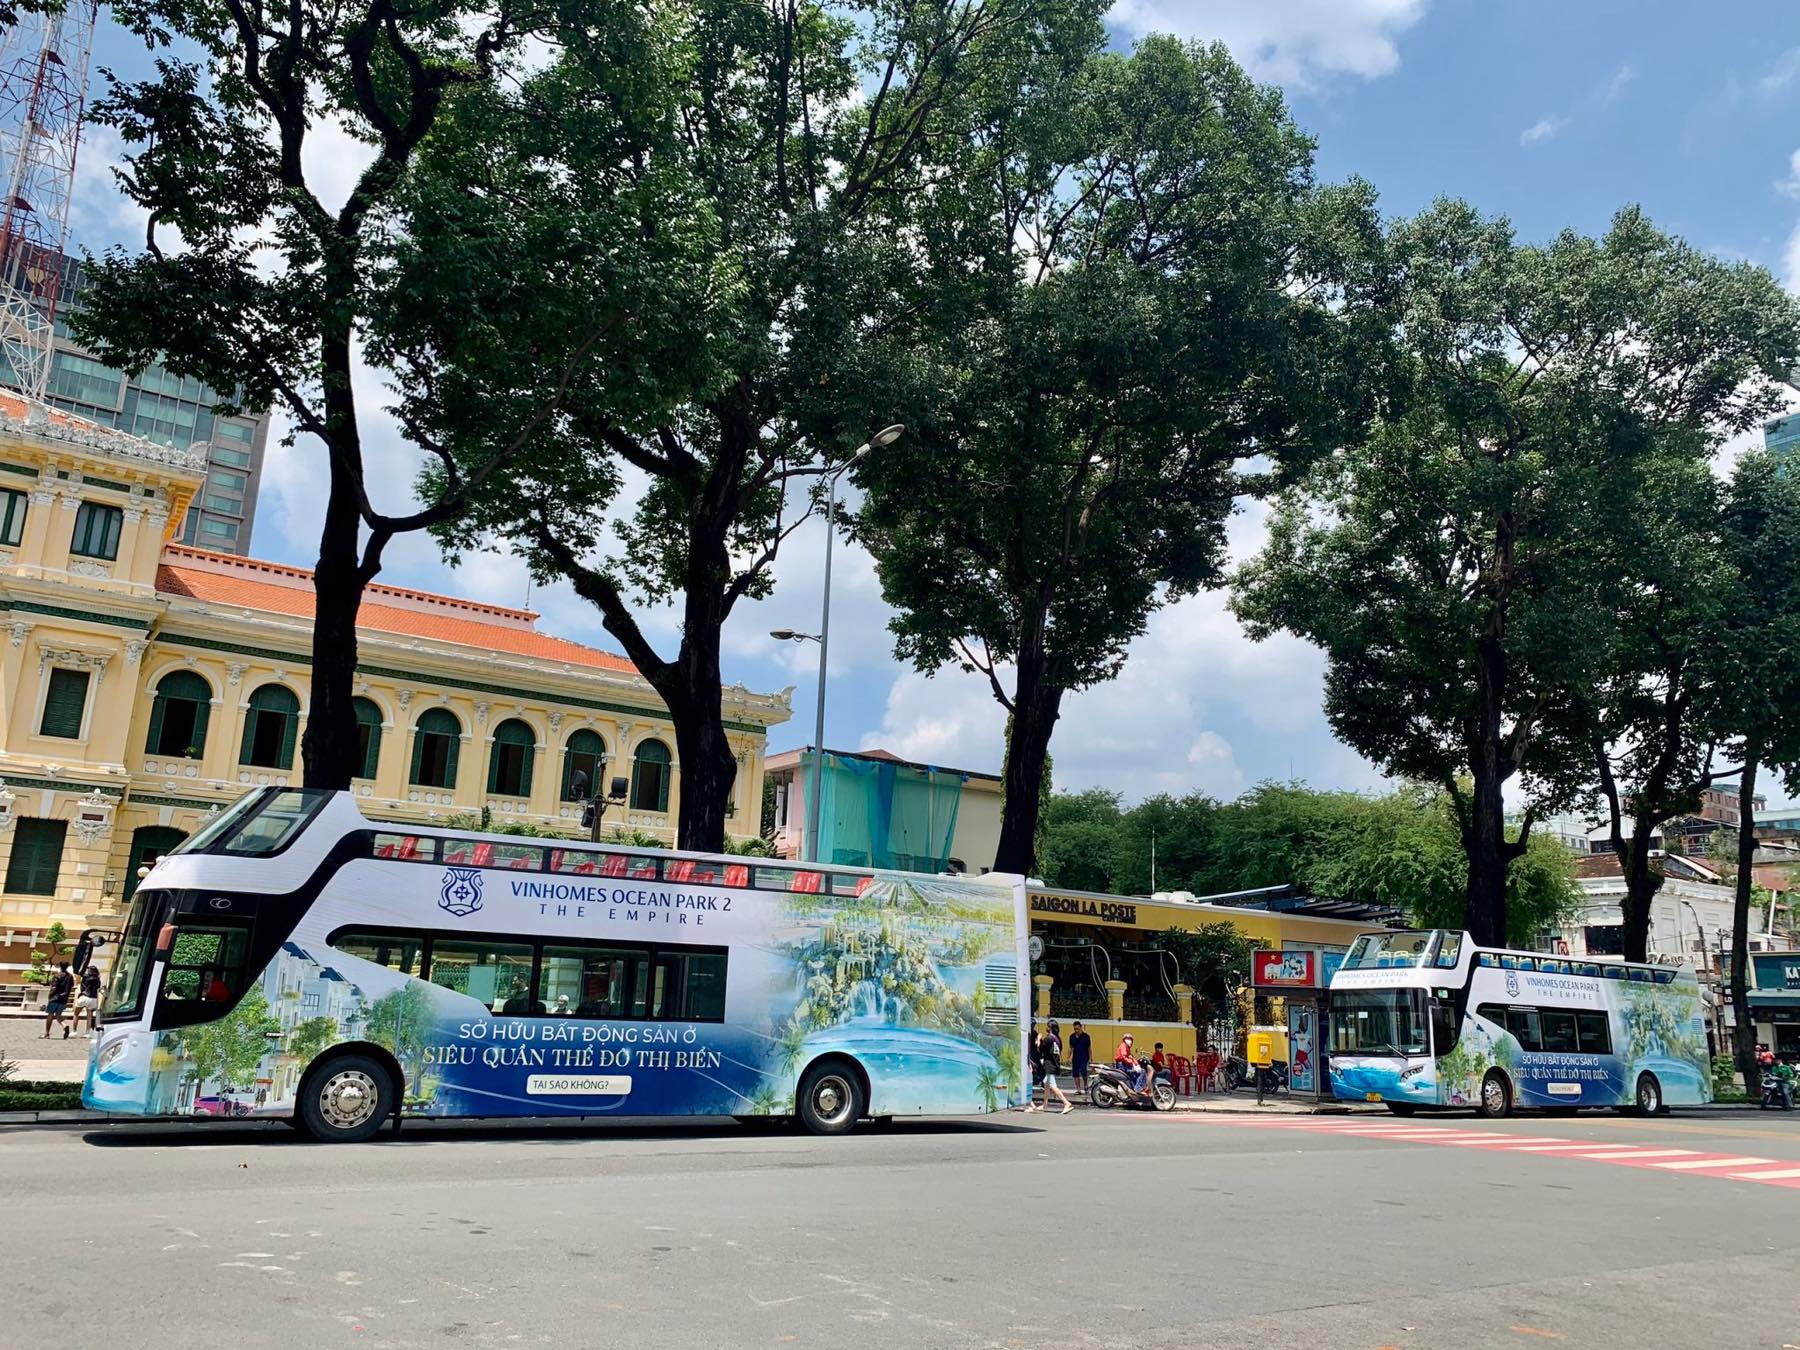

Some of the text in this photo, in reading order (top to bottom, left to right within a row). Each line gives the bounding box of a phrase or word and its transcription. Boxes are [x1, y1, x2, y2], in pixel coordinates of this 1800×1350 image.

[511, 881, 732, 912] VINHOMES OCEAN PARK 2
[1030, 895, 1136, 918] SAIGON LA POSTE
[540, 903, 704, 926] THE EMPIRE
[1526, 977, 1558, 989] VINHOMES
[1560, 980, 1579, 991] OCEAN
[1580, 982, 1594, 992] PARK
[1560, 990, 1592, 1000] EMPIRE
[459, 1019, 697, 1045] SỞ HỮU BẤT ĐỘNG SẢN Ở
[422, 1043, 721, 1071] SIÊU QUẦN THỂ ĐÔ THỊ BIỂN
[549, 1080, 568, 1090] SAO
[570, 1079, 609, 1090] KHÔNG?
